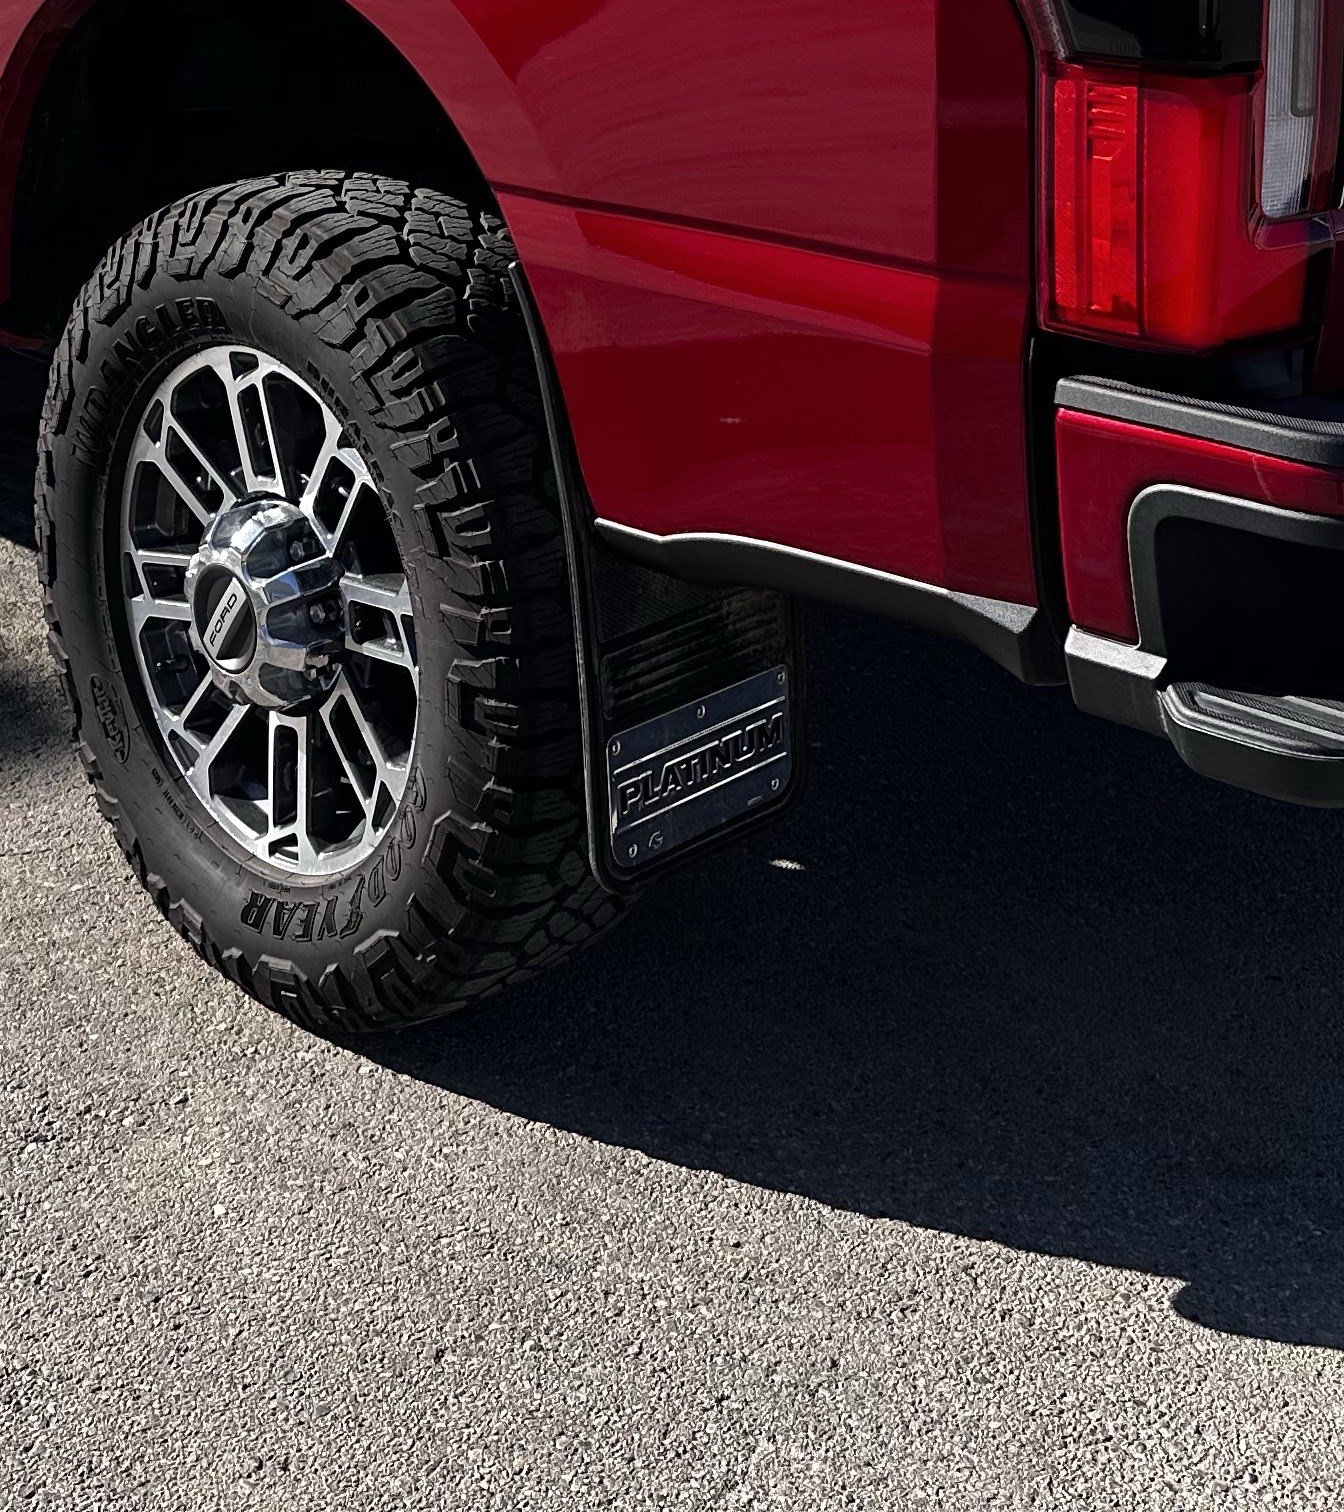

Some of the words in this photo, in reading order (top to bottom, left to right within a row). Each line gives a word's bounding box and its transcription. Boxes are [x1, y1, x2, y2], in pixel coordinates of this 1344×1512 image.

[72, 296, 233, 466] WRANGLER
[209, 592, 238, 647] FORD
[617, 711, 784, 816] PLATINUM
[240, 765, 428, 943] GOODYEAR
